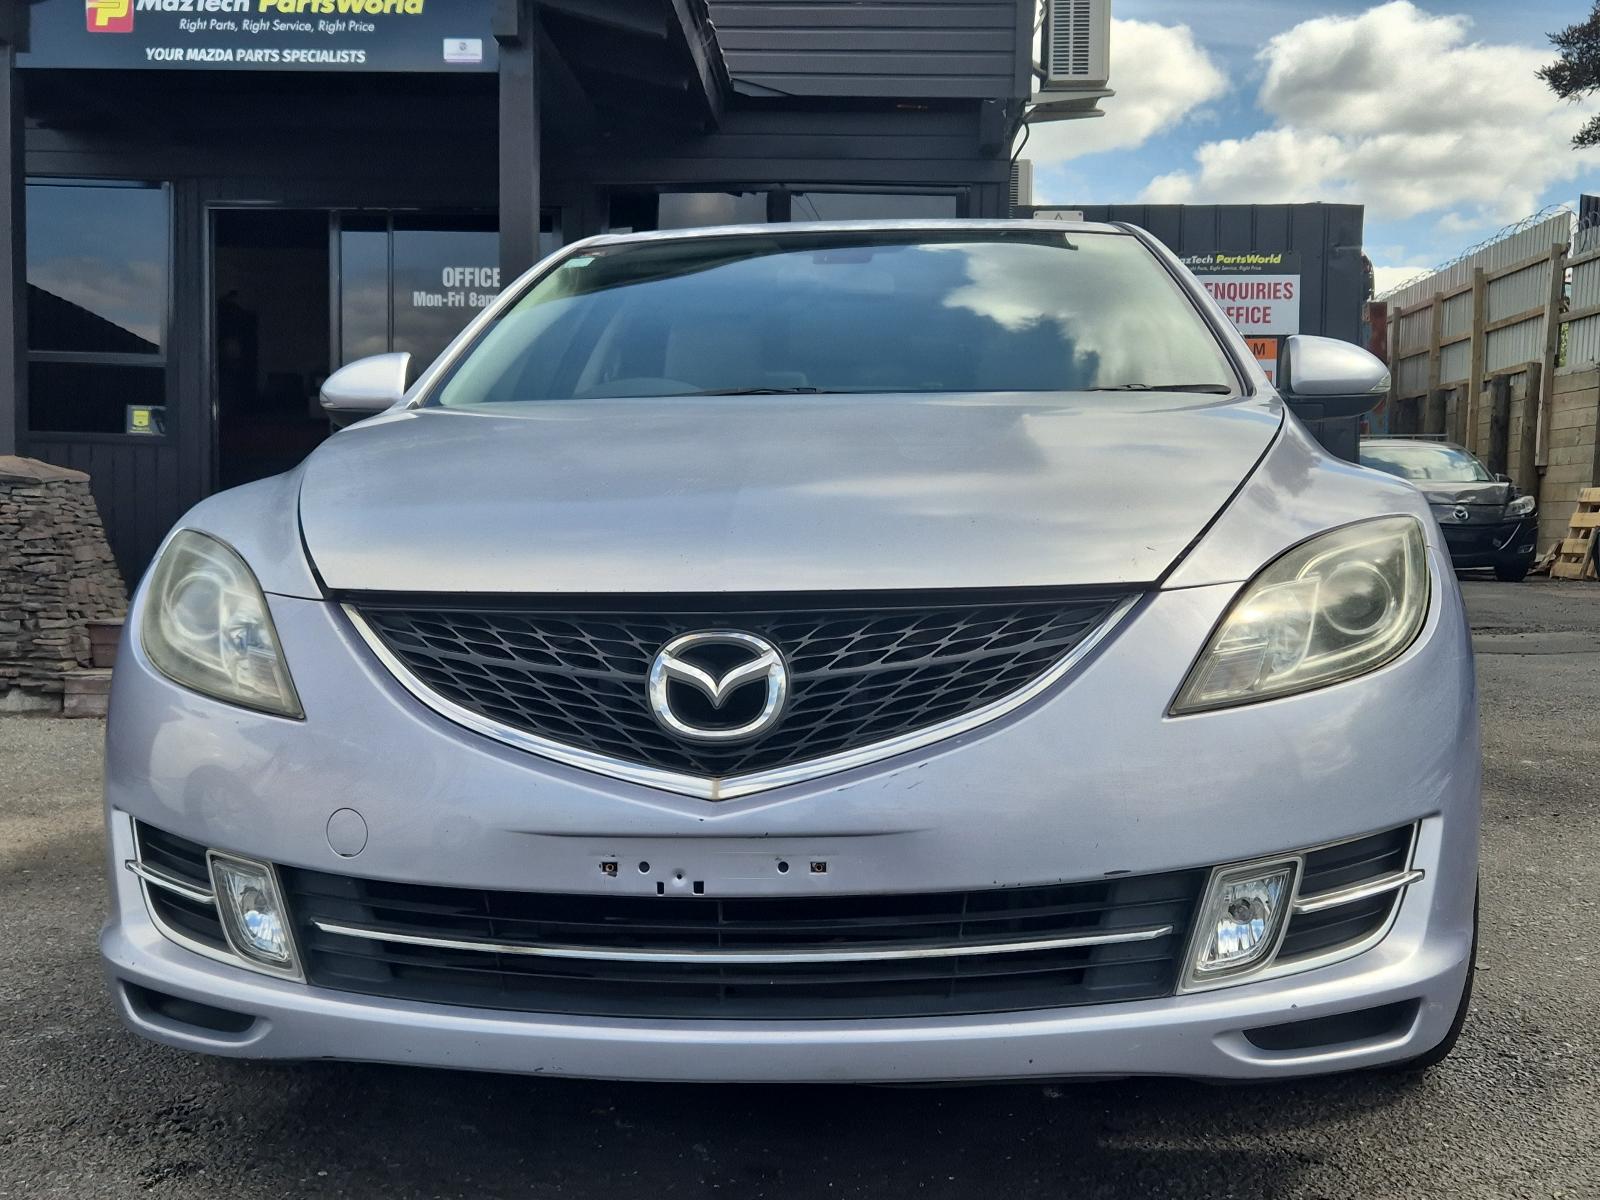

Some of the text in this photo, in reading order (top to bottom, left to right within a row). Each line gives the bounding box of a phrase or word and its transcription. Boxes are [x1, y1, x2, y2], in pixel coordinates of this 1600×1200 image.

[179, 18, 375, 34] Right Parts, Right Service, Right Price
[145, 47, 366, 63] YOUR MAZDA PARTS SPECIALISTS
[1216, 254, 1282, 264] PartsWorld
[442, 267, 501, 288] OFFICE
[413, 291, 465, 307] Mon-Fri
